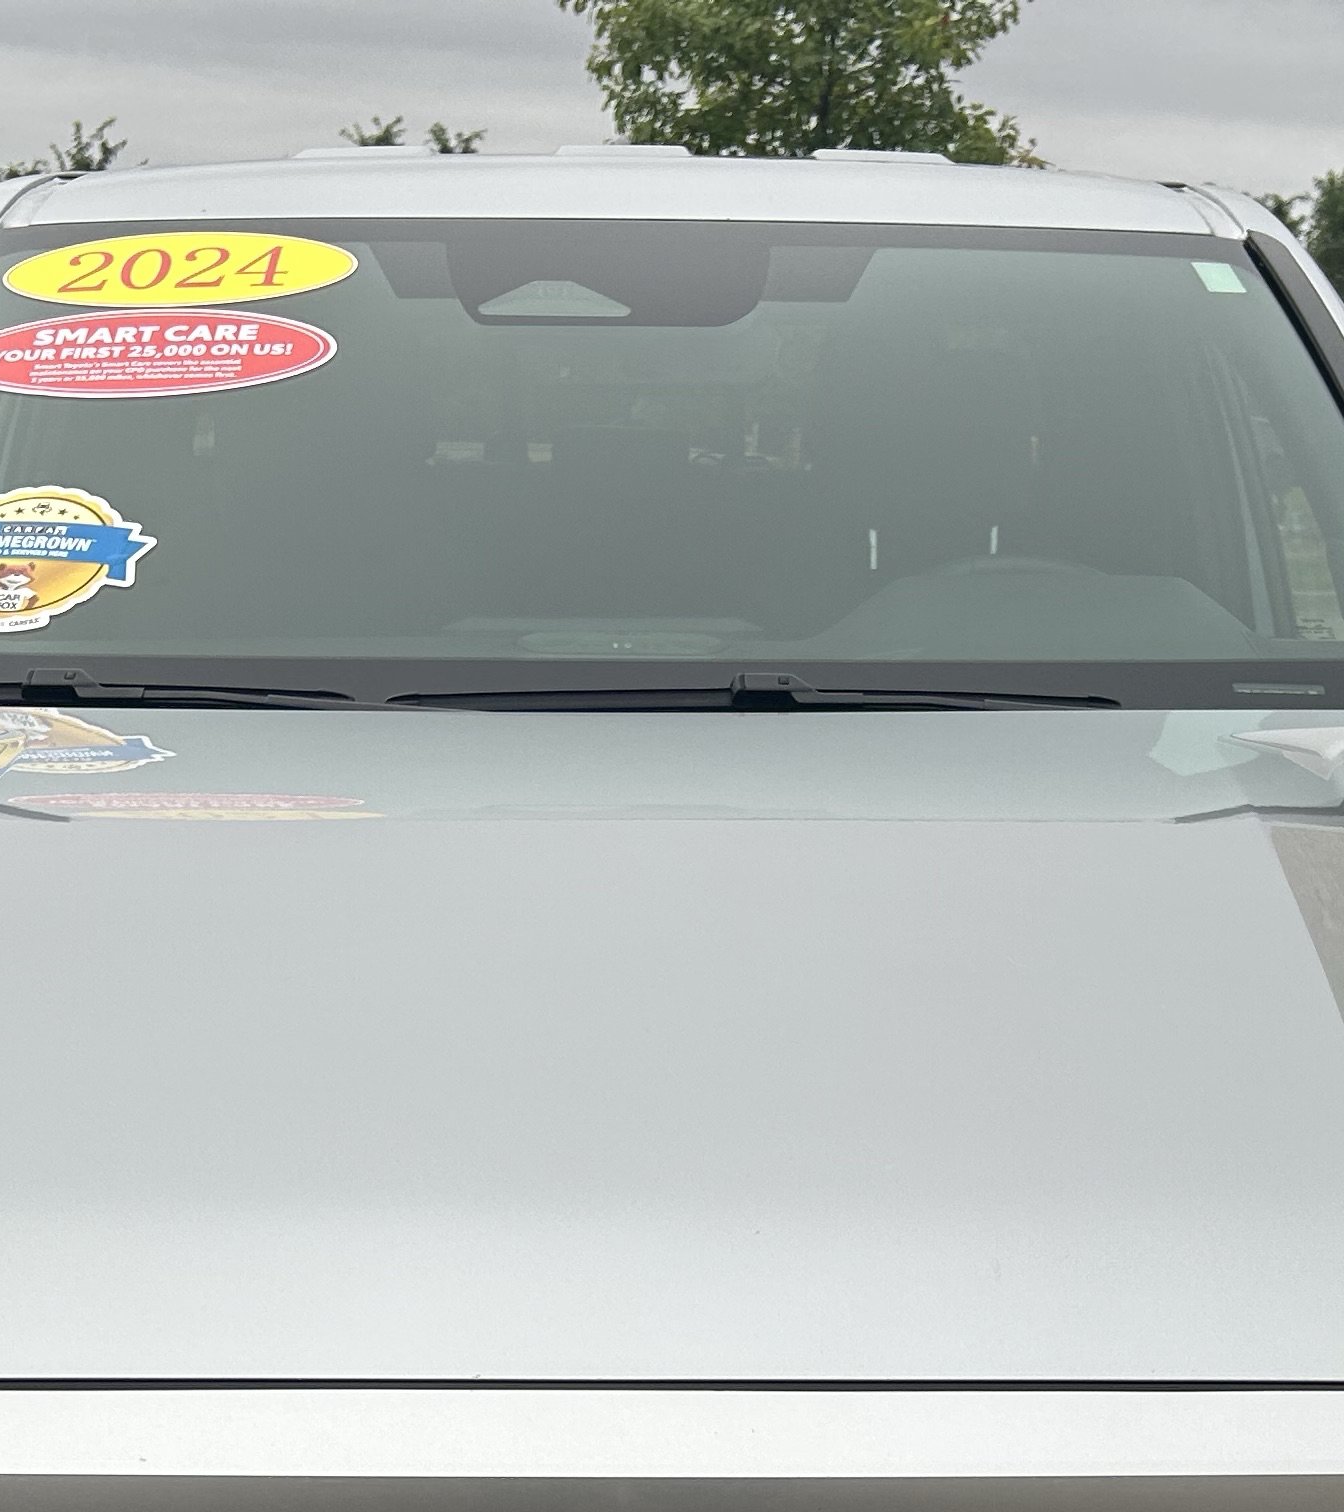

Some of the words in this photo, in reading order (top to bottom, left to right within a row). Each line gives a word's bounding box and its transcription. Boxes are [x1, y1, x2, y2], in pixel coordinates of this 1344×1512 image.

[57, 245, 288, 293] 2024
[33, 325, 160, 346] SMART
[164, 324, 260, 342] CARE
[60, 347, 124, 361] FIRST
[129, 345, 208, 360] 25,000
[210, 344, 250, 356] ON
[253, 343, 293, 356] US!
